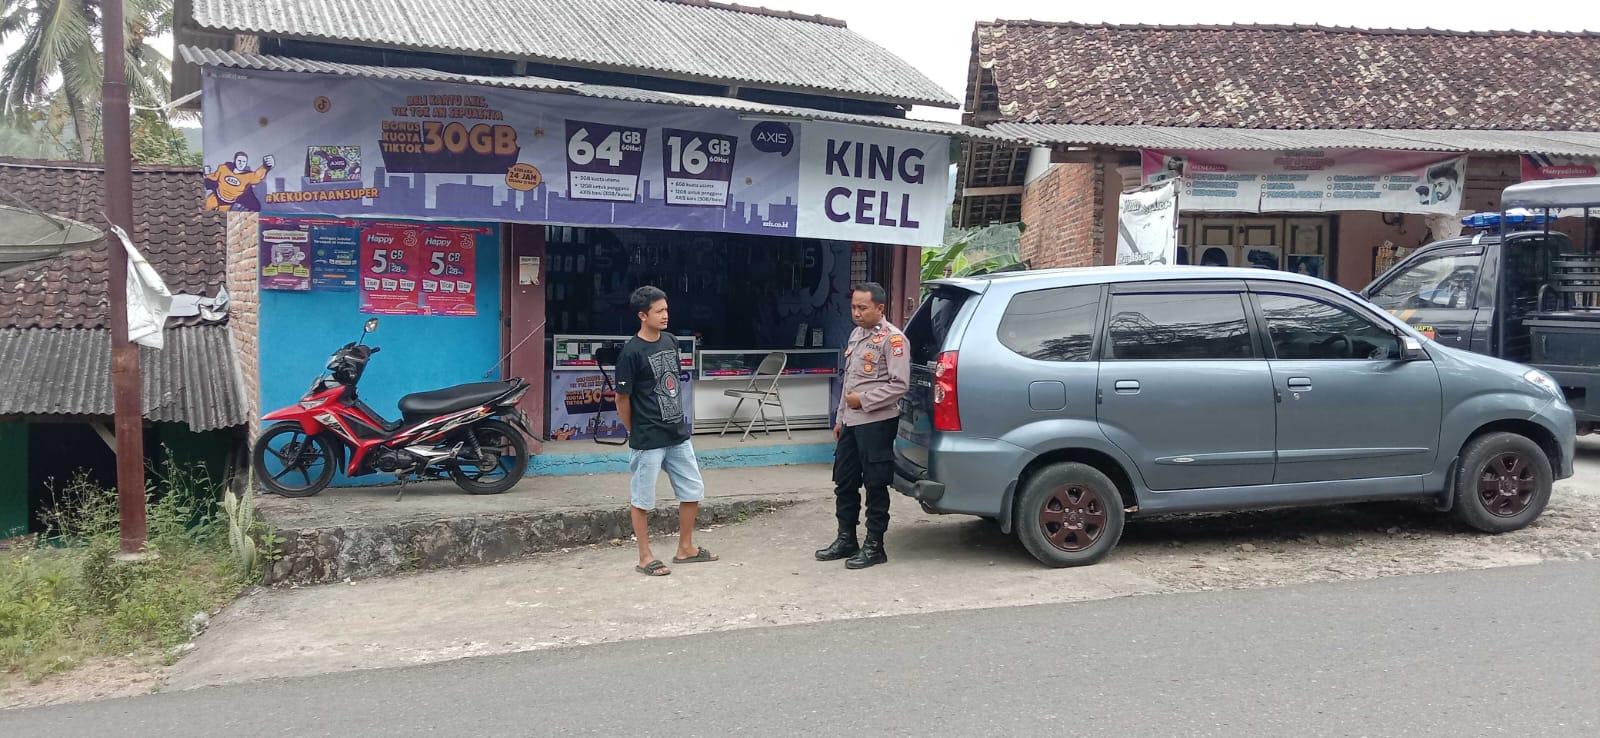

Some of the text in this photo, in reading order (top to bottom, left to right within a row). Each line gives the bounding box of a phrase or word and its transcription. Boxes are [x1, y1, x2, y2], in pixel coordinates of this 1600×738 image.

[381, 120, 420, 131] BONUS
[382, 131, 421, 142] KUOTA
[423, 121, 518, 156] 30GB
[757, 131, 787, 144] AXIS
[383, 143, 422, 153] TIKTOK
[568, 127, 641, 166] 64 GB
[667, 136, 731, 174] 16 GB
[825, 138, 926, 184] KING
[521, 173, 537, 181] JAM
[265, 188, 379, 204] #KEKUOTAANSUPER
[824, 186, 920, 229] CELL
[367, 234, 394, 245] Happy
[425, 236, 452, 247] Happy
[371, 249, 405, 274] 5 GB
[429, 252, 461, 276] 5 GB
